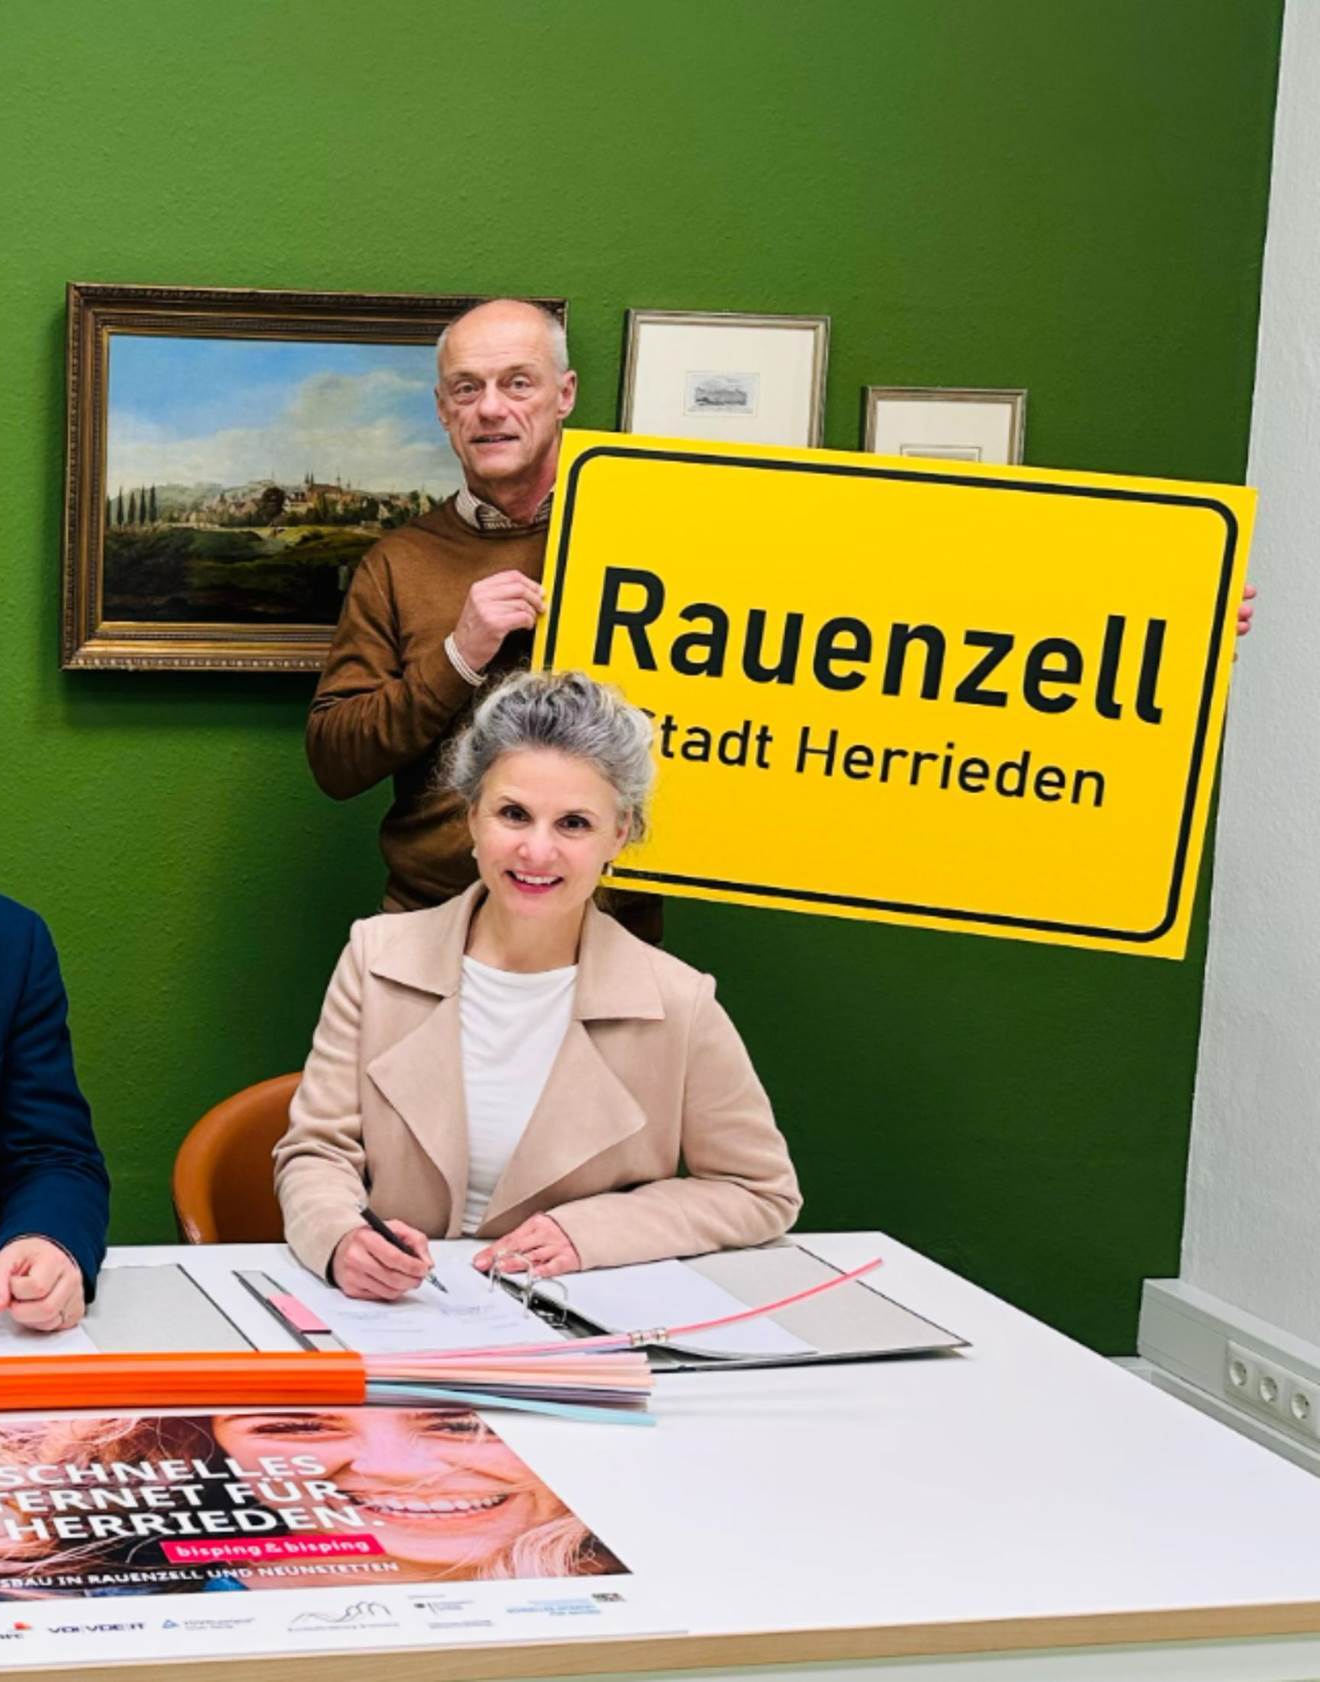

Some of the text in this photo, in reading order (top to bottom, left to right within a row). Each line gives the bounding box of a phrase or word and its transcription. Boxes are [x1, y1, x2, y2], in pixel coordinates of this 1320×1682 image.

[592, 565, 1168, 725] Rauenzell
[639, 707, 1107, 808] tadt Herrieden
[223, 1476, 351, 1504] FÜR
[2, 1505, 386, 1542] HERRIEDEN.
[175, 1537, 370, 1558] bisping & bisping
[57, 1574, 82, 1587] IN
[88, 1569, 204, 1584] RAUENZELL
[207, 1566, 253, 1580] UND
[258, 1561, 399, 1578] NEUNSTETTEN
